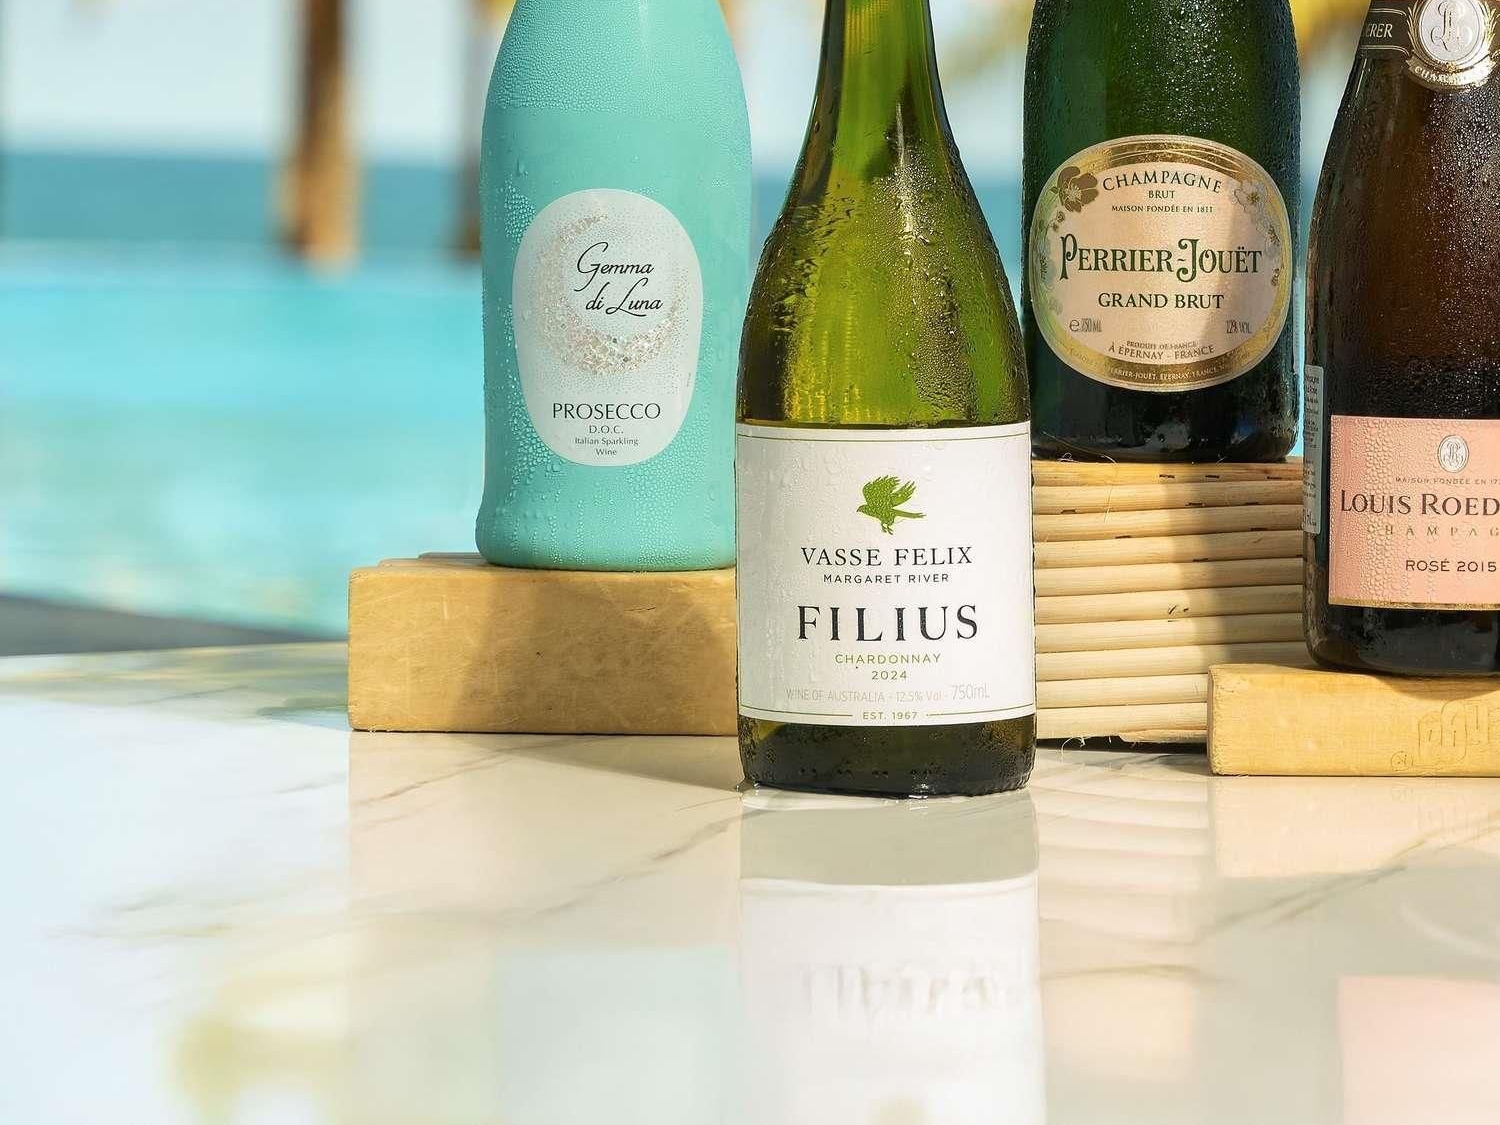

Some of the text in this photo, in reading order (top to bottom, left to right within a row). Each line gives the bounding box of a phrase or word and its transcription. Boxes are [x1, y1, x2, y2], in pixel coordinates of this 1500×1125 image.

[1102, 170, 1222, 194] CHAMPAGNE
[1148, 190, 1175, 199] BRUT
[1146, 204, 1179, 212] FONDÉE
[574, 241, 655, 292] Gemma
[586, 277, 664, 317] di Luna
[1098, 292, 1225, 309] GRAND BRUT
[1118, 344, 1163, 360] ÉPERNAY
[1174, 345, 1216, 360] FRANCE
[552, 402, 661, 420] PROSECCO
[588, 425, 624, 434] D.O.C.
[575, 436, 639, 447] Italian Sparkling
[595, 448, 618, 456] Wine
[1340, 489, 1412, 515] LOUIS
[801, 546, 973, 567] VASSE FELIX
[1405, 557, 1497, 573] ROSÉ 2015
[823, 573, 950, 584] MARGARET RIVER
[796, 604, 979, 643] FILIUS
[835, 653, 942, 665] CHARDONNAY
[871, 670, 908, 680] 2024
[785, 688, 809, 700] WINE
[827, 690, 886, 703] AUSTRALIA
[862, 711, 918, 720] EST. 1967
